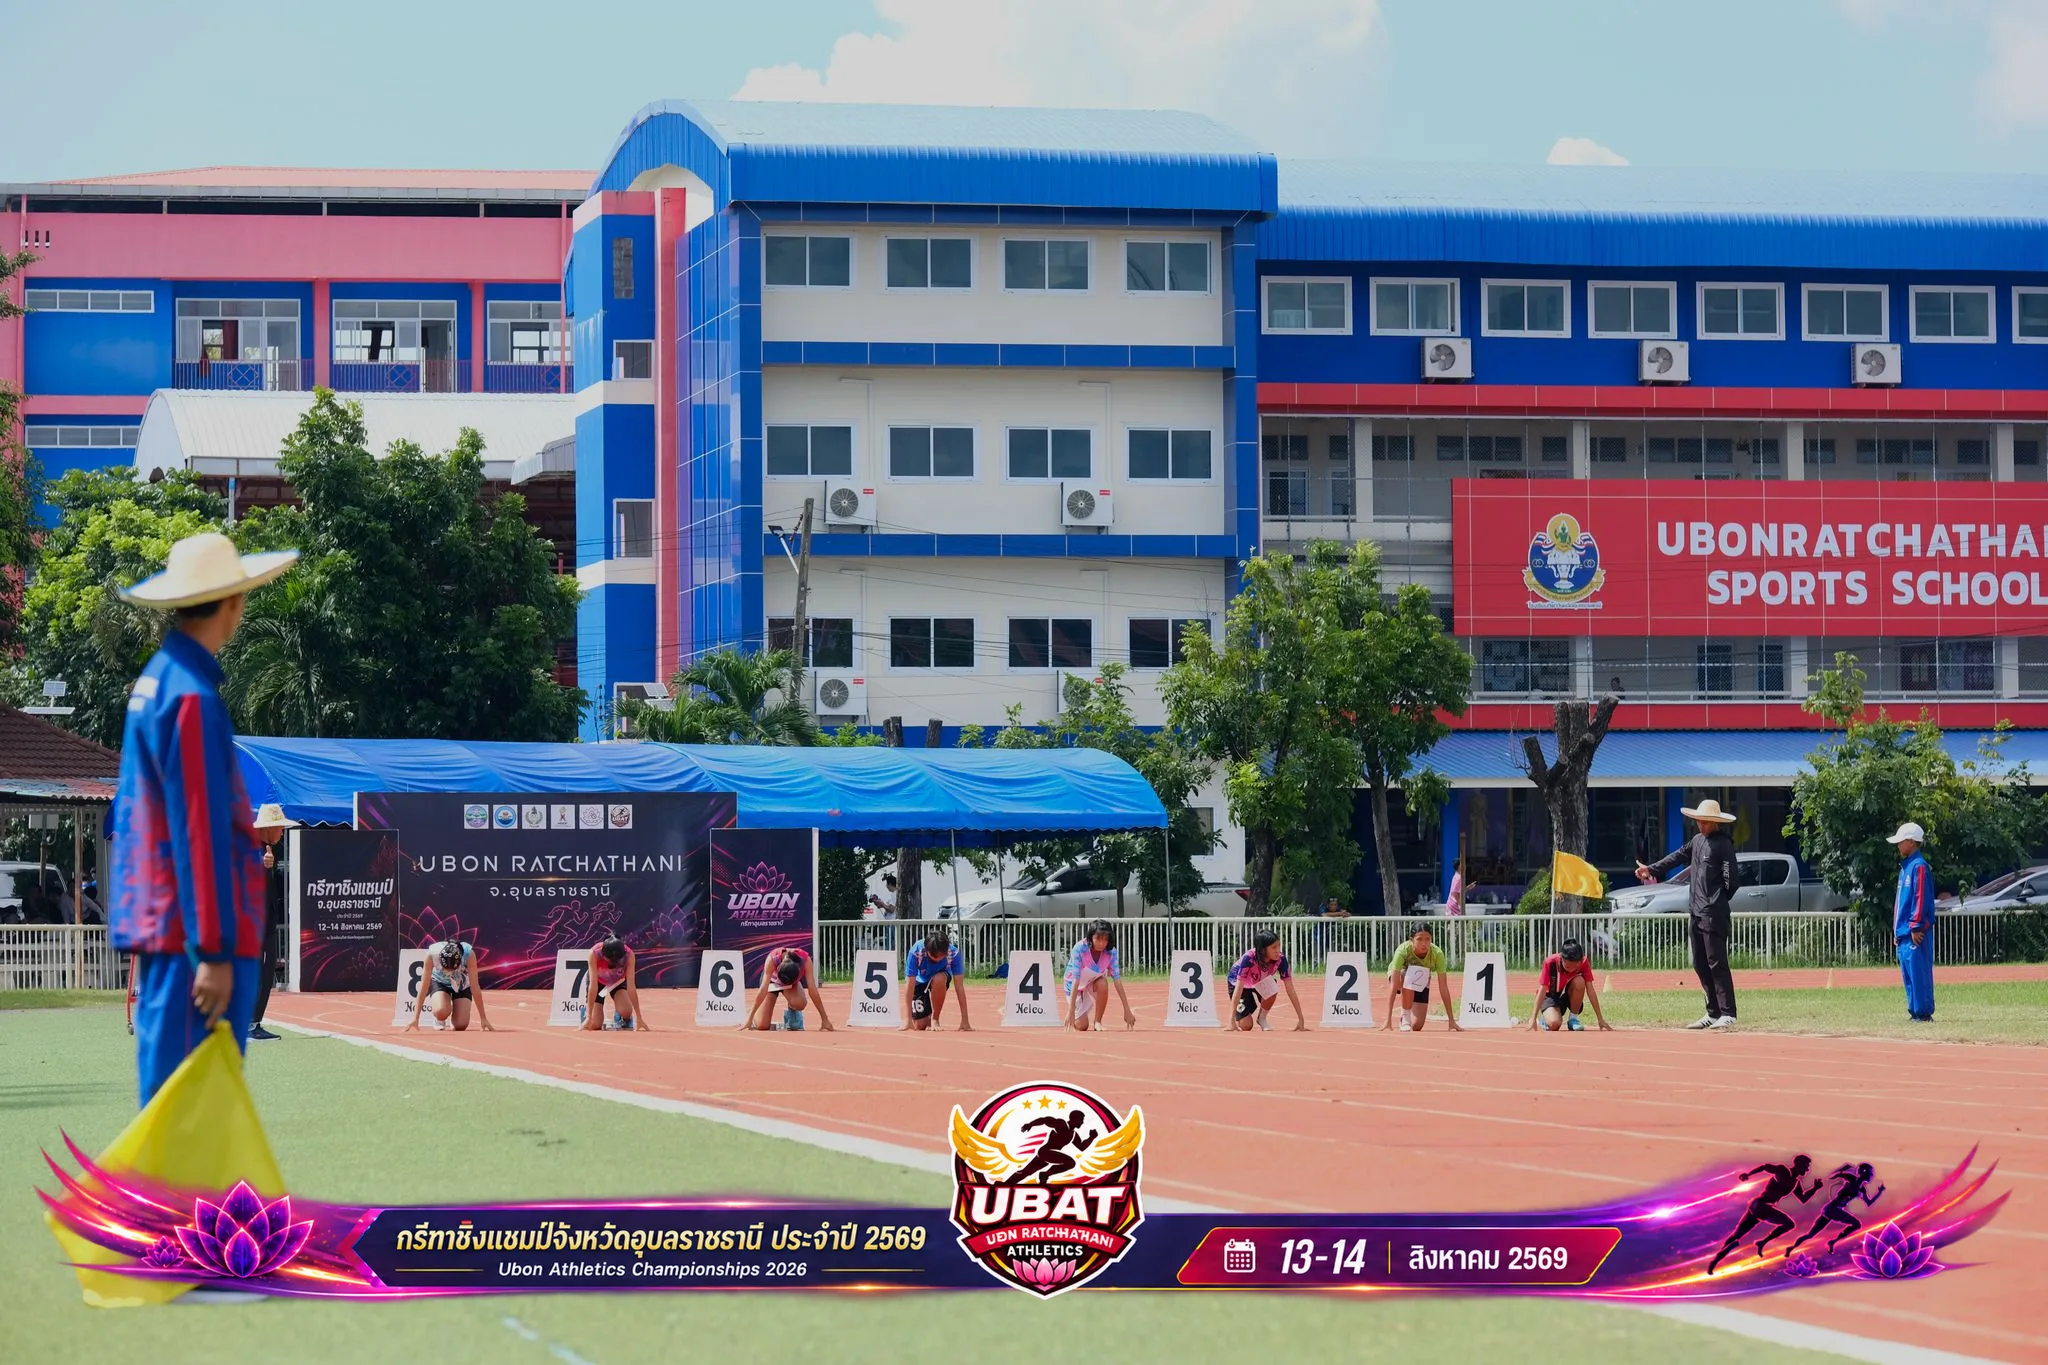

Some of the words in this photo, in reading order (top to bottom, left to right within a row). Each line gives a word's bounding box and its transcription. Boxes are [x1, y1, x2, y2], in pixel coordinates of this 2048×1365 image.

[1658, 522, 2048, 558] UBONRATCHATHA
[1707, 570, 1868, 605] SPORTS
[1892, 571, 2048, 606] SCHOOL
[420, 855, 498, 872] UBON
[512, 855, 682, 872] RATCHATHANI
[317, 896, 382, 913] จ.อุบลราชธานี
[489, 883, 610, 901] จ.อุบลราชธานี
[728, 893, 800, 910] UBON
[366, 922, 383, 930] 2569
[729, 909, 798, 920] ATHLETICS
[566, 960, 589, 998] 7
[710, 960, 734, 998] 6
[864, 962, 888, 1000] 5
[1019, 963, 1043, 1000] 4
[1180, 962, 1203, 999] 3
[1335, 964, 1359, 1001] 2
[1411, 970, 1424, 987] 2
[1476, 963, 1494, 1001] 1
